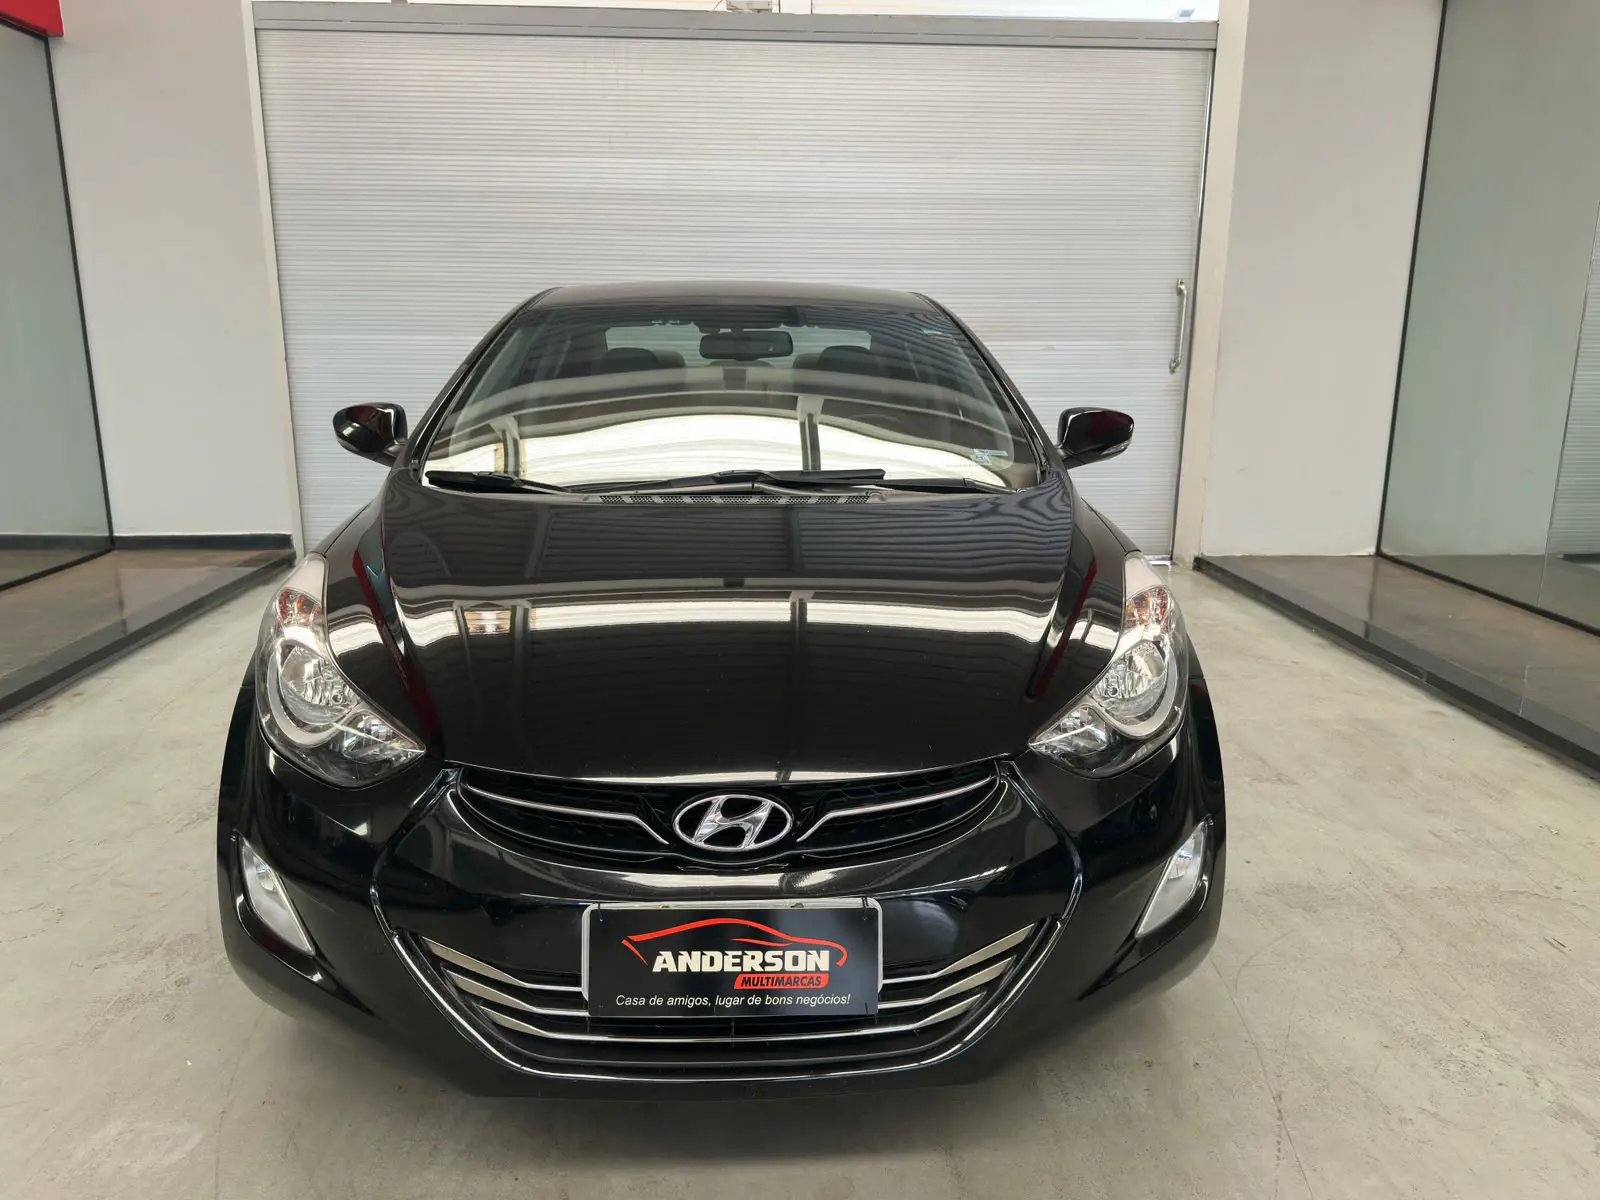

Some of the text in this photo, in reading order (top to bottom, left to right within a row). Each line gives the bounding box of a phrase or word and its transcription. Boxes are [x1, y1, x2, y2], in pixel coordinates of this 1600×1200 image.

[652, 950, 830, 972] ANDERSON
[740, 976, 822, 988] MULTIMARCAS
[615, 993, 851, 1009] Casa de amigos, lugar de bons negócios!
